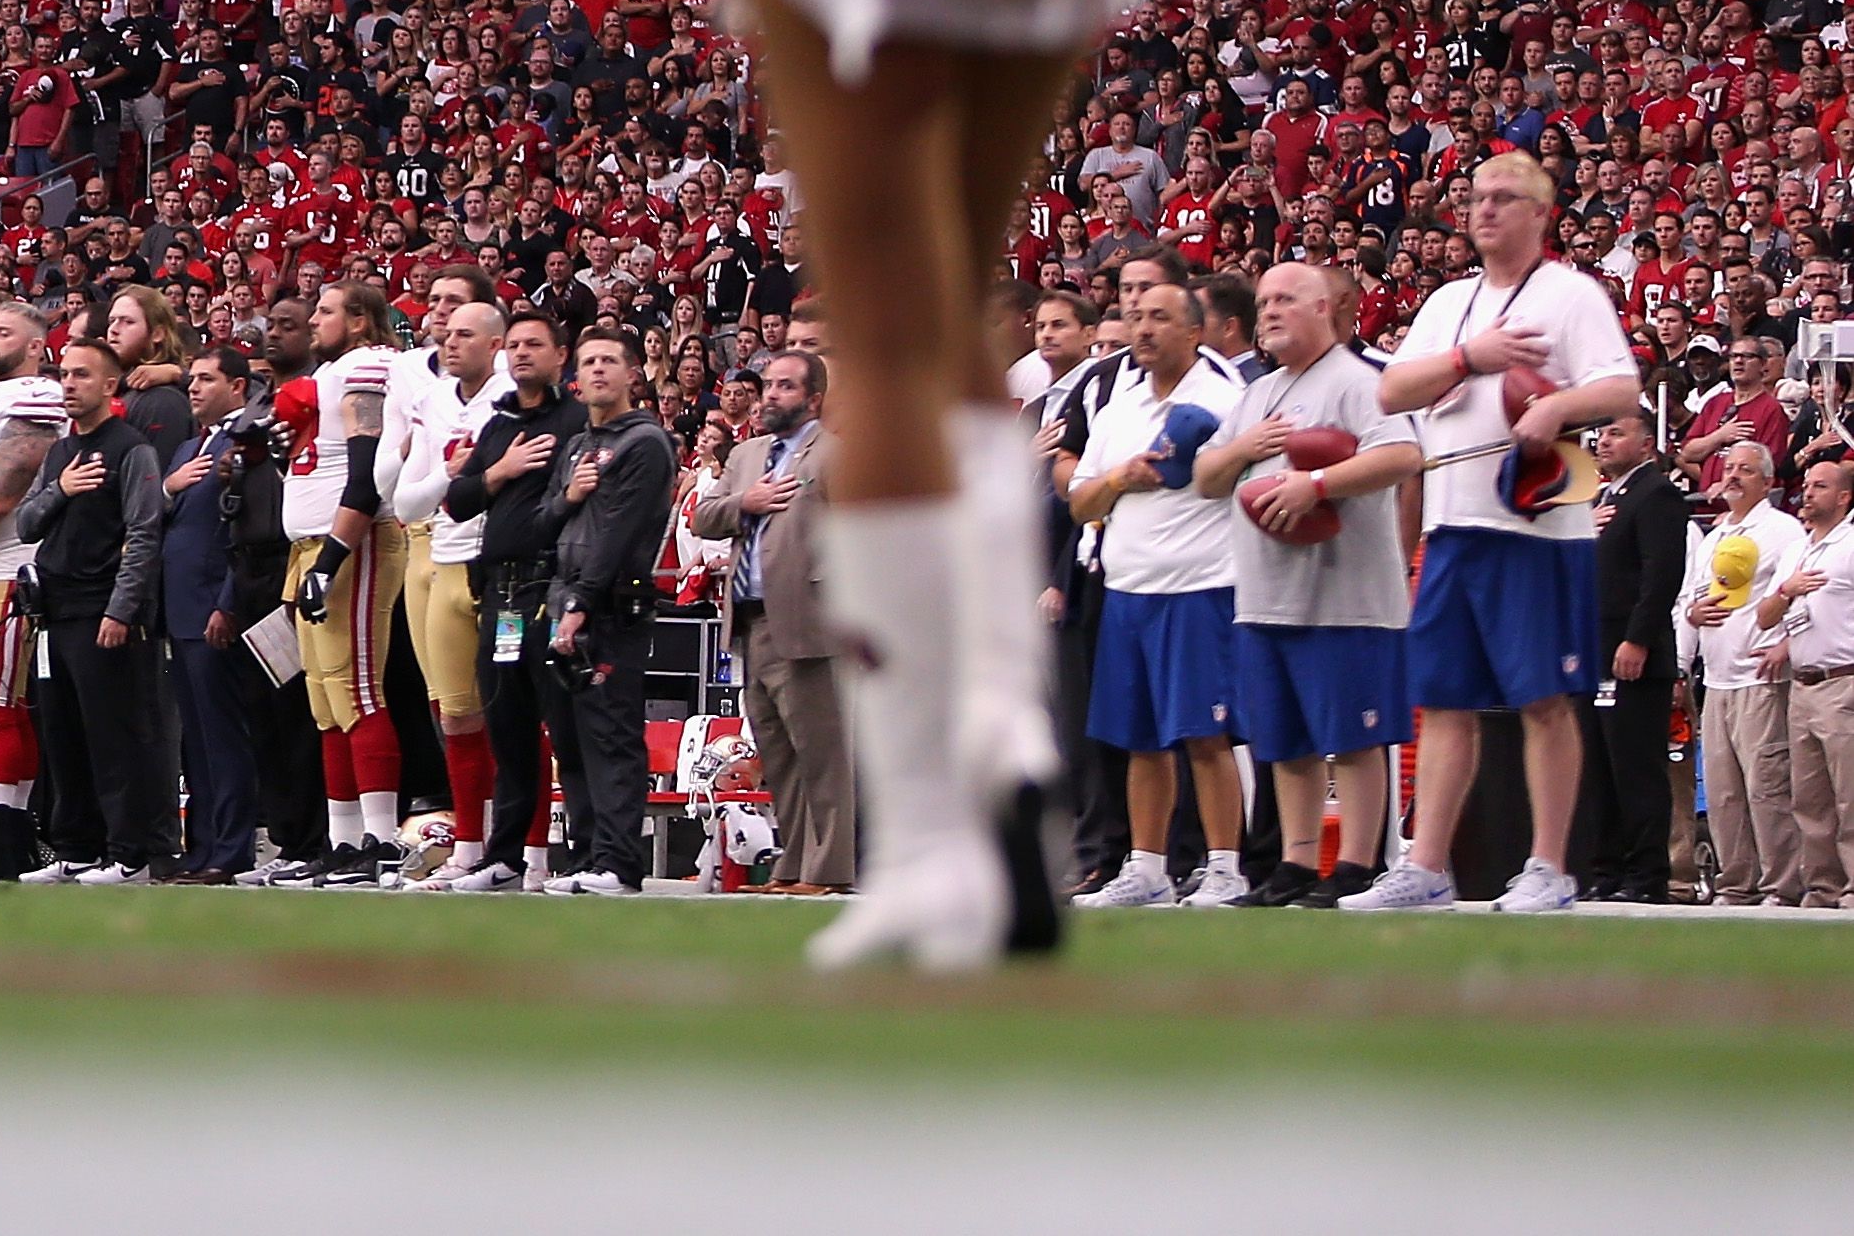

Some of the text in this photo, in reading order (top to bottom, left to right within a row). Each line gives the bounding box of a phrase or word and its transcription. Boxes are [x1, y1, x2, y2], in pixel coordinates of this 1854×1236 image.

[1413, 32, 1426, 60] 3
[1444, 40, 1469, 68] 21
[397, 168, 428, 197] 40
[1367, 176, 1393, 207] 18
